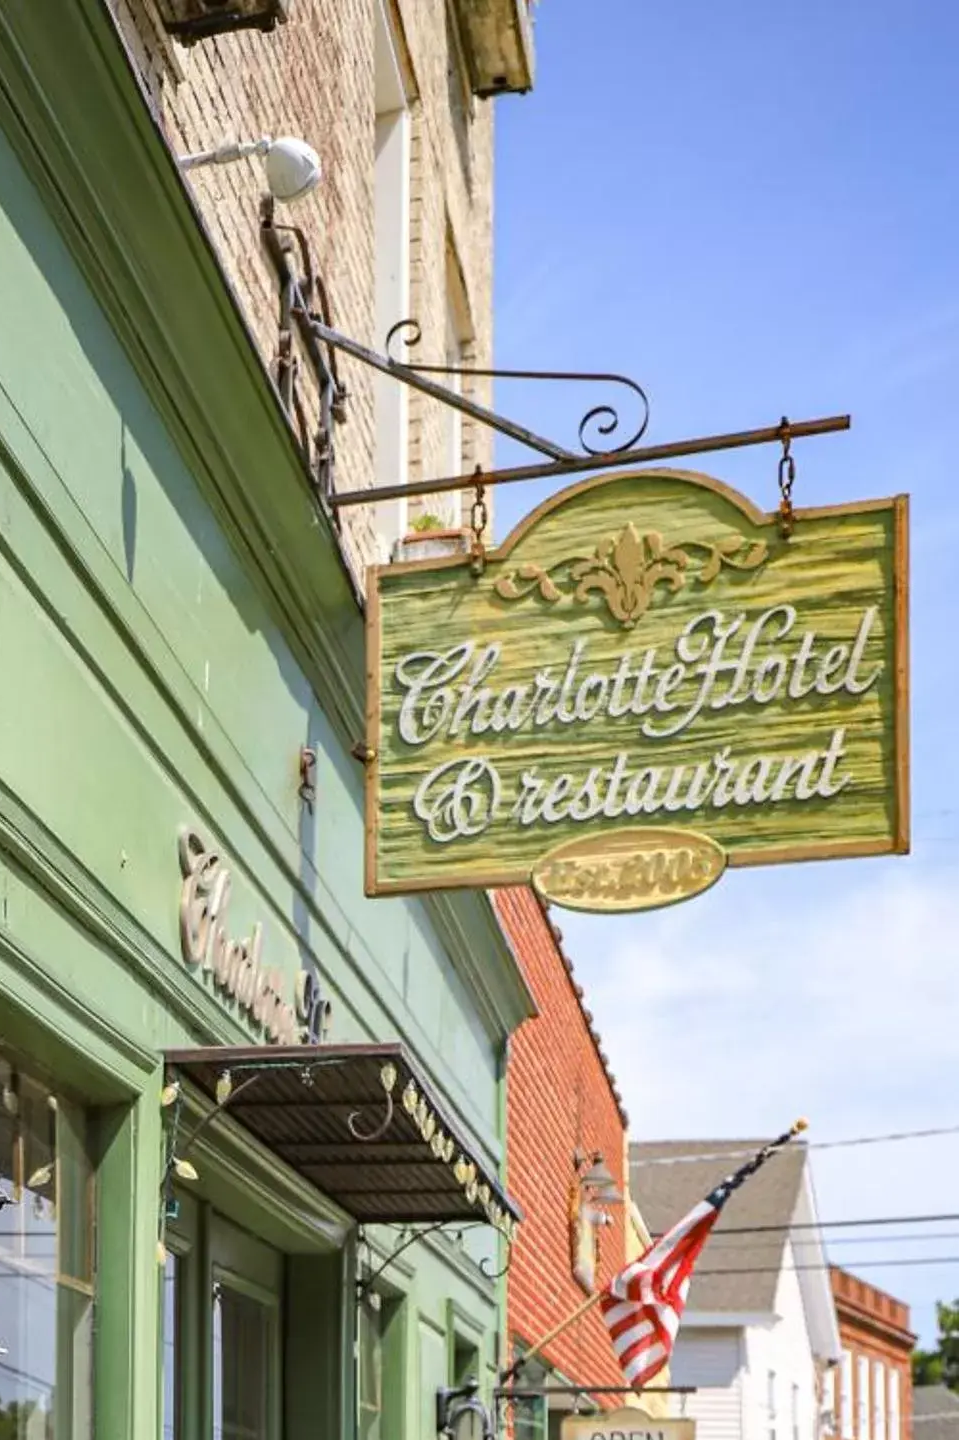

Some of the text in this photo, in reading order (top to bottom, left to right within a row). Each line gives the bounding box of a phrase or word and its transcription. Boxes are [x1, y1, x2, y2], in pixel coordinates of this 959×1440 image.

[394, 604, 885, 745] Charlotte Hotel
[512, 727, 854, 825] restaurant
